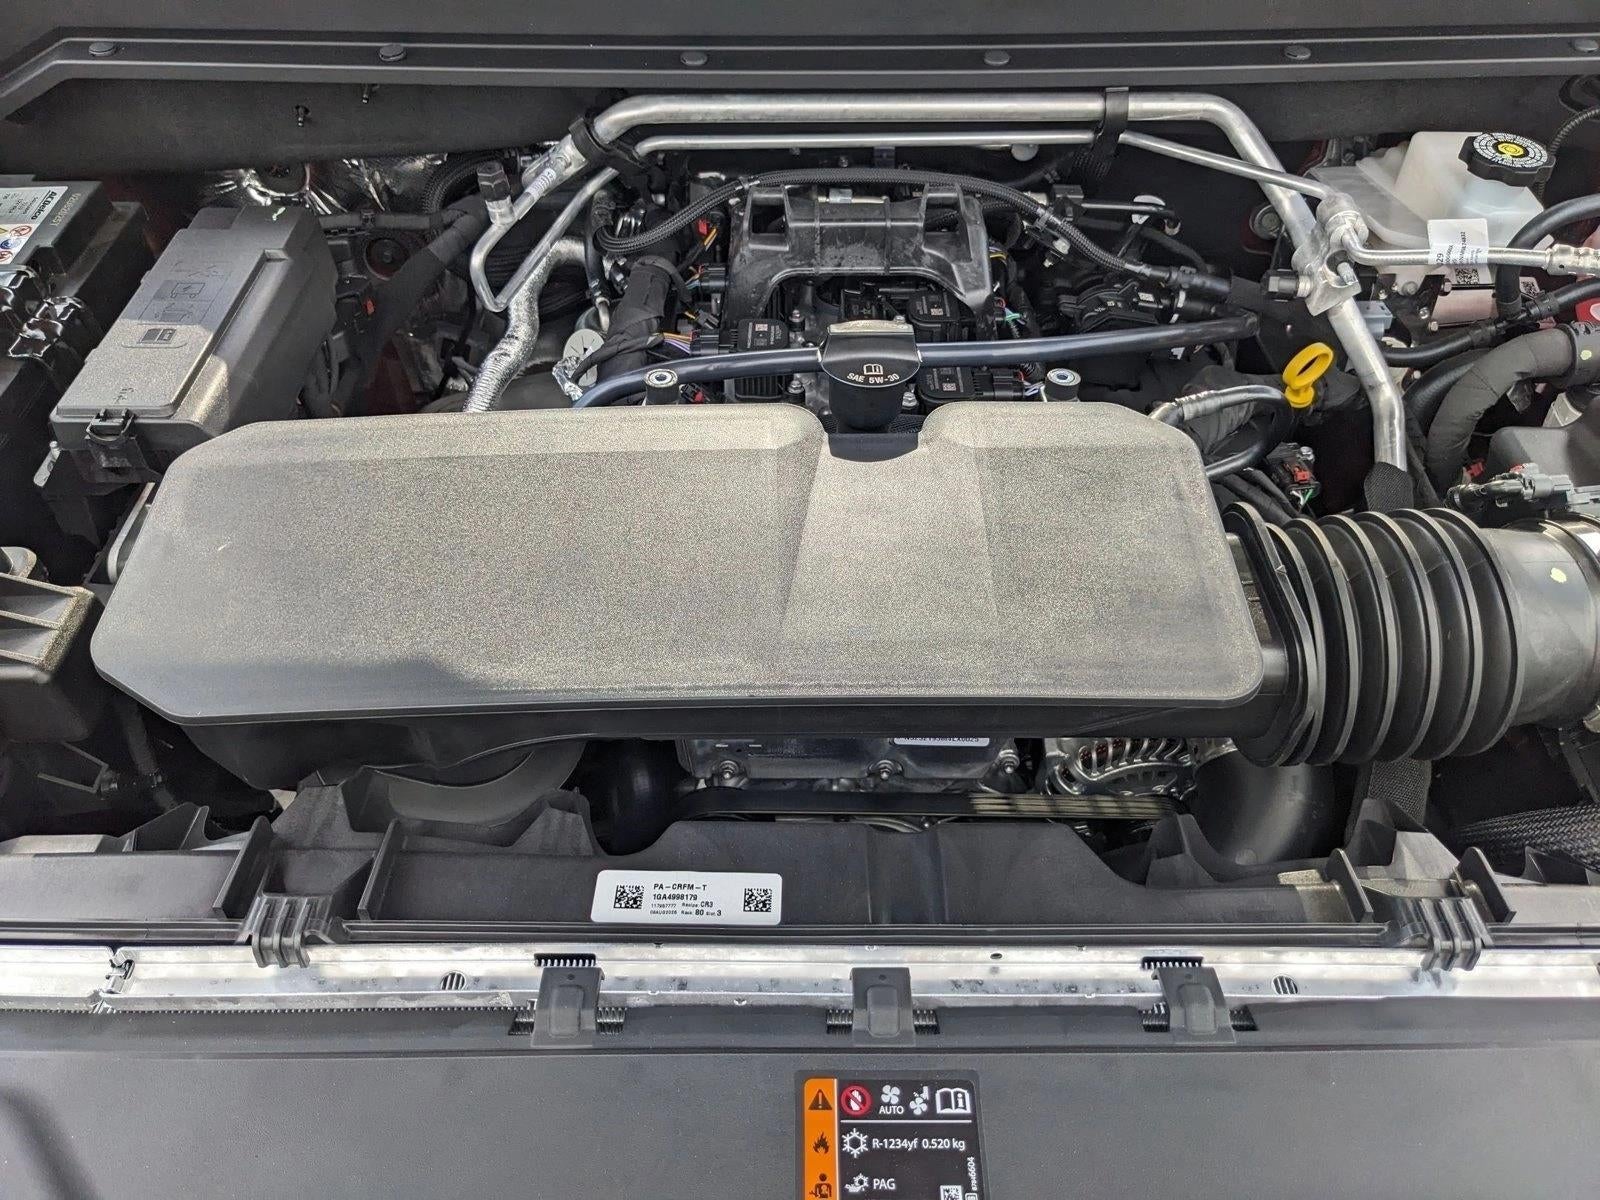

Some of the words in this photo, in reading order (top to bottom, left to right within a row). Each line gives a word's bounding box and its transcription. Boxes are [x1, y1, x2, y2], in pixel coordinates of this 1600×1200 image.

[31, 191, 57, 220] ACDelco
[1436, 253, 1444, 264] 29
[846, 372, 866, 383] SAE
[879, 1105, 904, 1115] AUTO
[872, 1138, 918, 1151] R-1234yf
[922, 1138, 951, 1149] 0.520
[952, 1138, 965, 1151] kg
[873, 1178, 896, 1190] PAG
